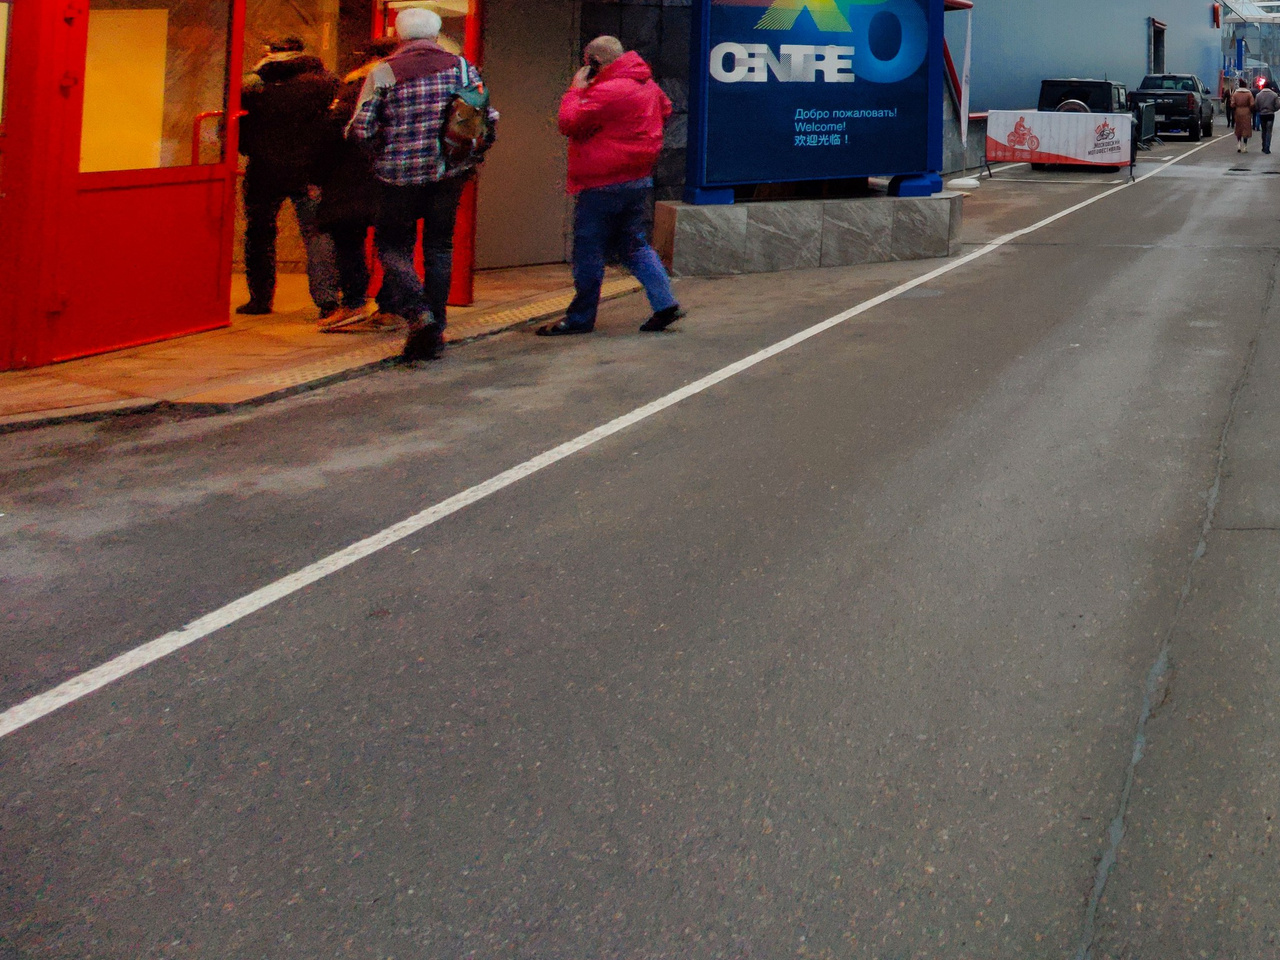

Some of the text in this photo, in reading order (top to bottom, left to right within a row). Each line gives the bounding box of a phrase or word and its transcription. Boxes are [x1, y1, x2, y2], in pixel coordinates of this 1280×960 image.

[709, 42, 855, 83] CENTRE
[794, 107, 897, 120] Добро пожаловать!
[794, 121, 846, 132] Welcome!
